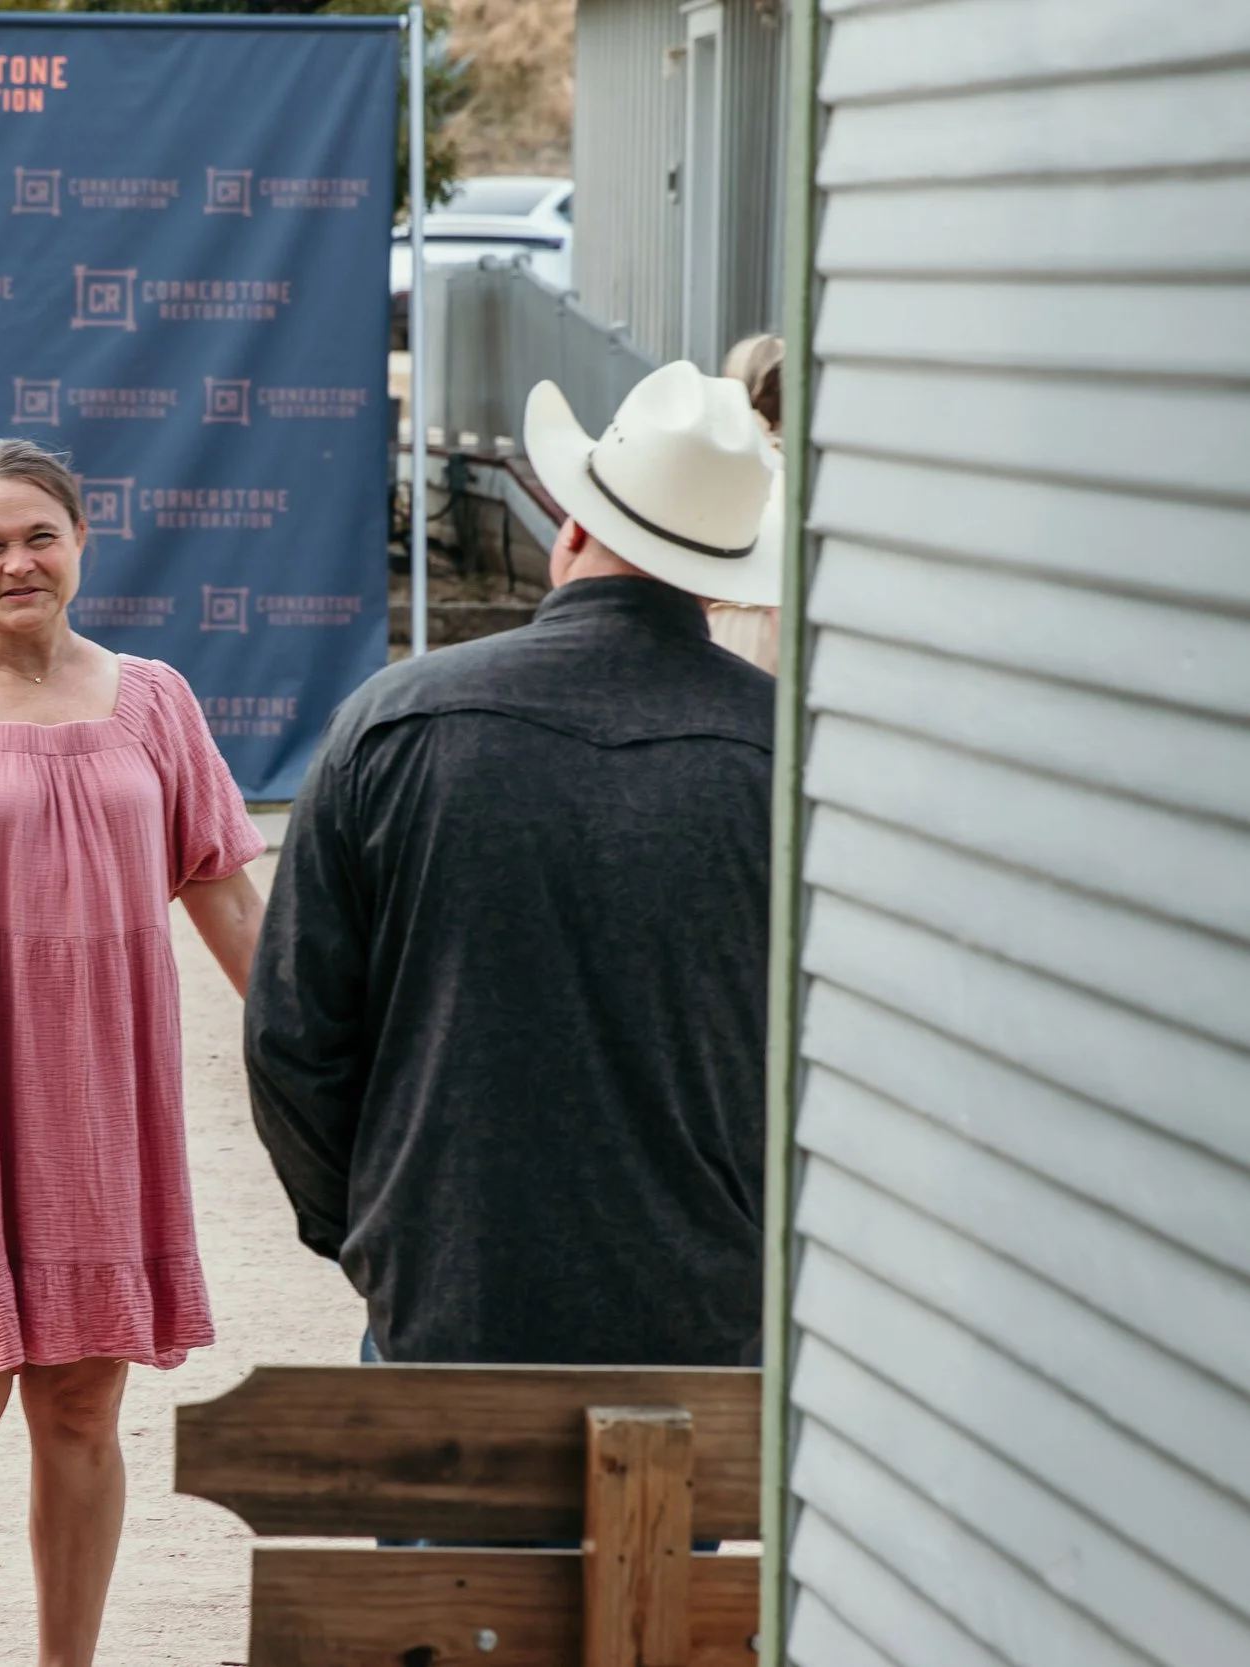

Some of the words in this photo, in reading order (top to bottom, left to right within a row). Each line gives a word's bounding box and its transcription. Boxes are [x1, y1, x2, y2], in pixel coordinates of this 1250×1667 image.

[25, 181, 49, 203] CR
[68, 177, 180, 197] CORNERSTONE
[217, 181, 240, 203] CR
[259, 177, 369, 196] CORNERSTONE
[88, 283, 121, 313] CR
[141, 281, 292, 304] CORNERSTONE
[159, 303, 277, 320] RESTORATION
[24, 390, 49, 413] CR
[67, 388, 178, 406] CORNERSTONE
[216, 390, 239, 412] CR
[258, 387, 368, 406] CORNERSTONE
[87, 492, 118, 522] CR
[139, 489, 289, 512] CORNERSTONE
[156, 512, 274, 528] RESTORATION
[256, 595, 363, 613] CORNERSTONE
